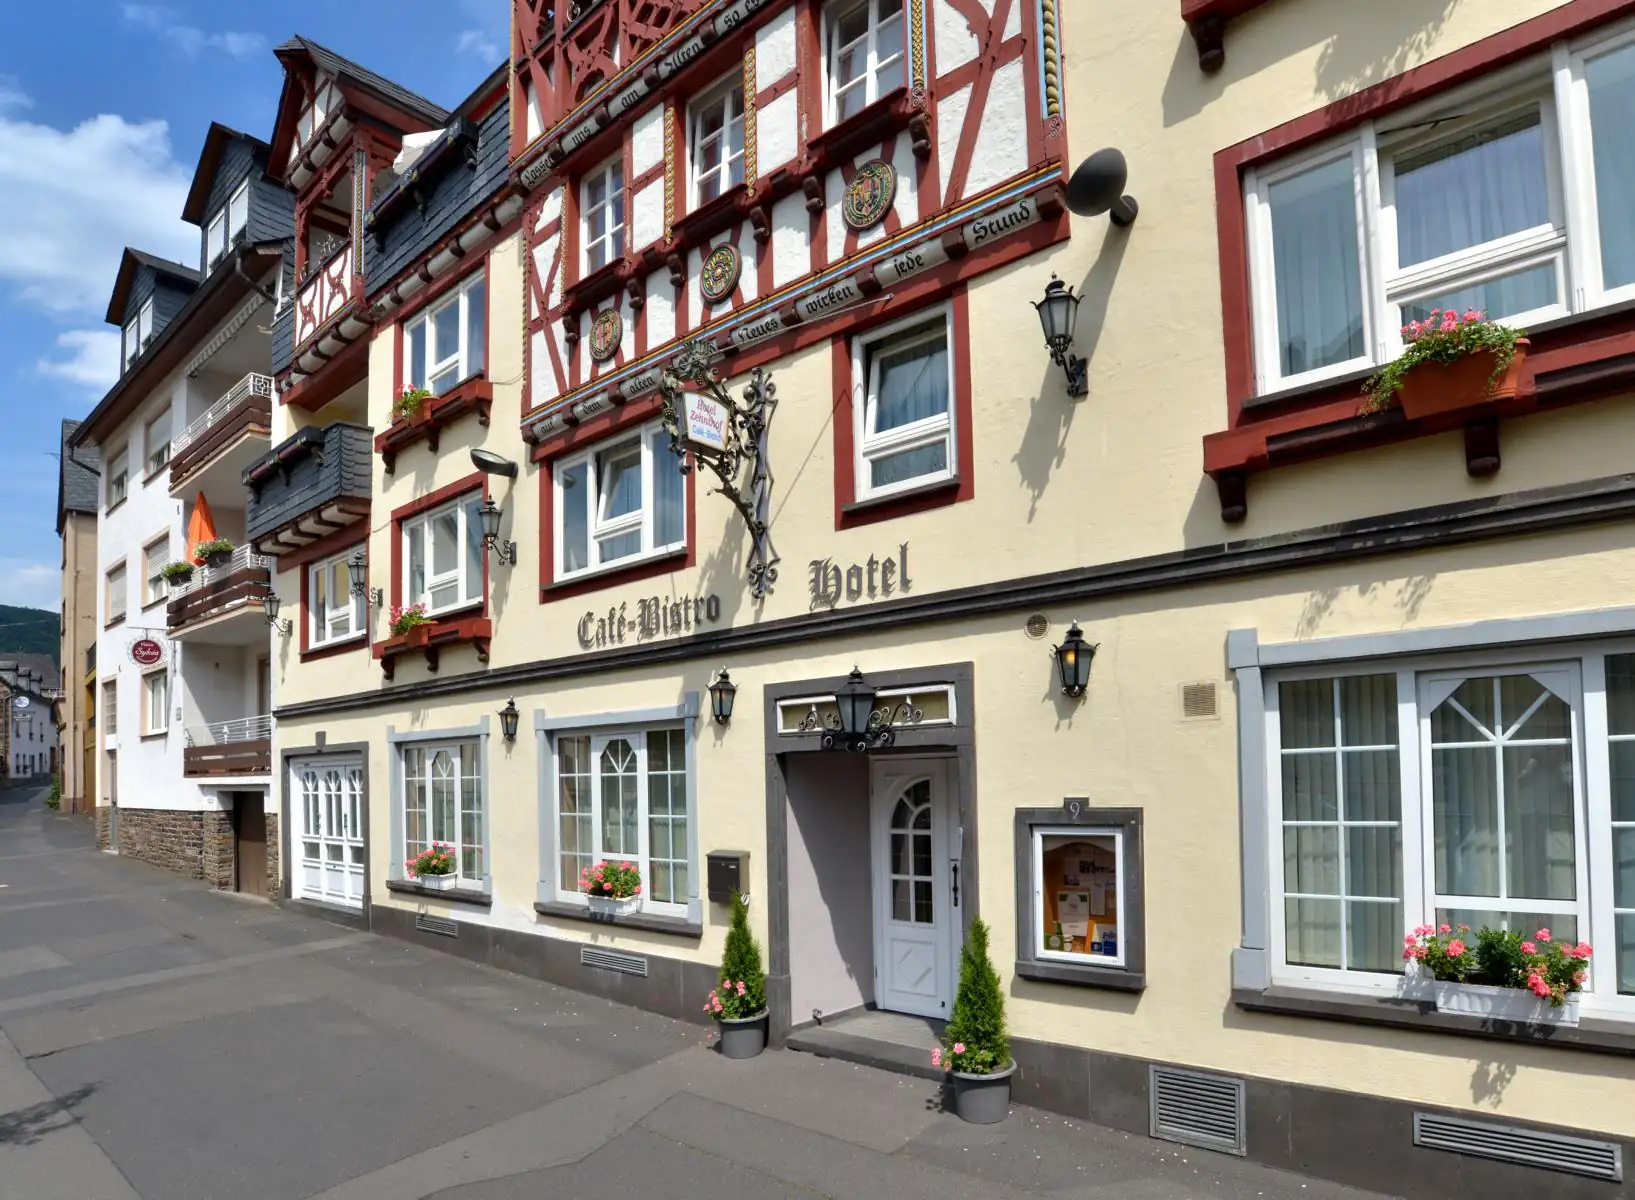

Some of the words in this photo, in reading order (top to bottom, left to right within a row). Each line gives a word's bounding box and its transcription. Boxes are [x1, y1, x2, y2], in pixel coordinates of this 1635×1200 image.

[571, 126, 592, 145] uns
[621, 89, 640, 108] am
[805, 283, 855, 314] wirken
[894, 254, 926, 277] jede
[972, 203, 1031, 243] Stund
[540, 417, 557, 433] auf
[582, 400, 602, 415] dem
[629, 375, 655, 394] alten
[696, 398, 717, 416] Hotel
[808, 541, 913, 613] Hotel
[577, 593, 721, 650] Café-Bistro
[1069, 801, 1078, 819] 9
